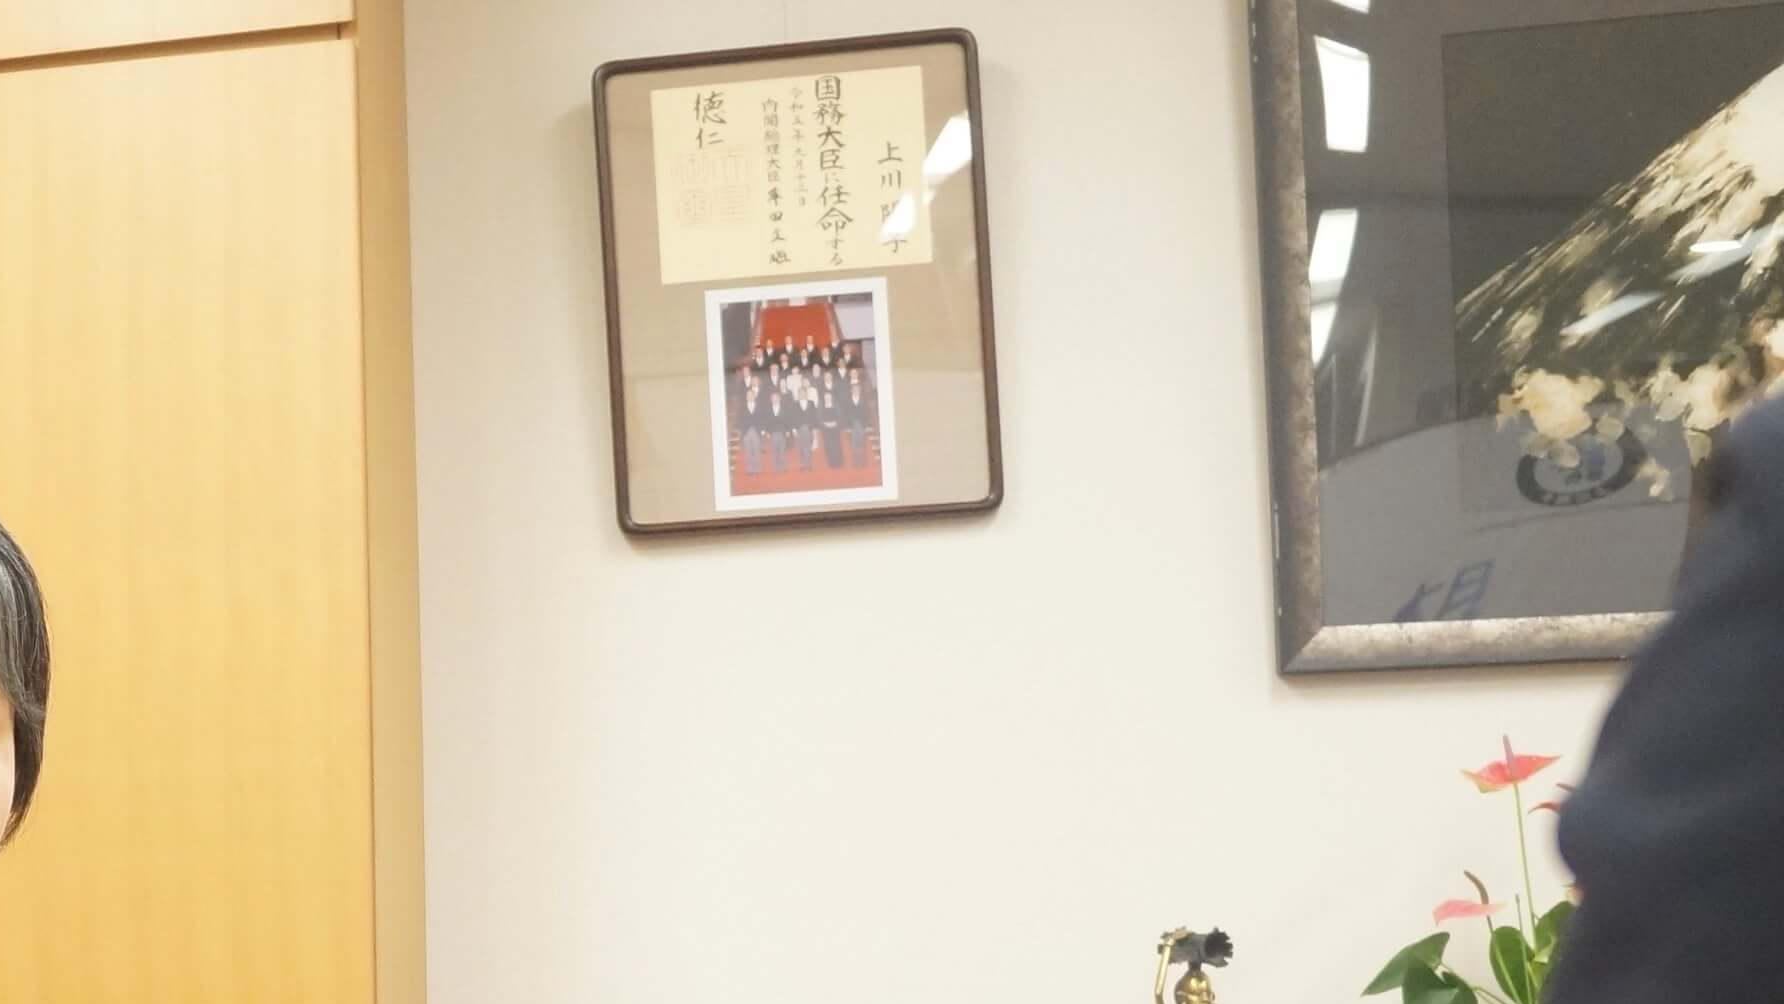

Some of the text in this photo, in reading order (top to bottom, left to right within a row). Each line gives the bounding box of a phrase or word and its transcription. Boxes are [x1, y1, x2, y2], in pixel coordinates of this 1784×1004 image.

[813, 75, 854, 266] 国務大臣に任命する
